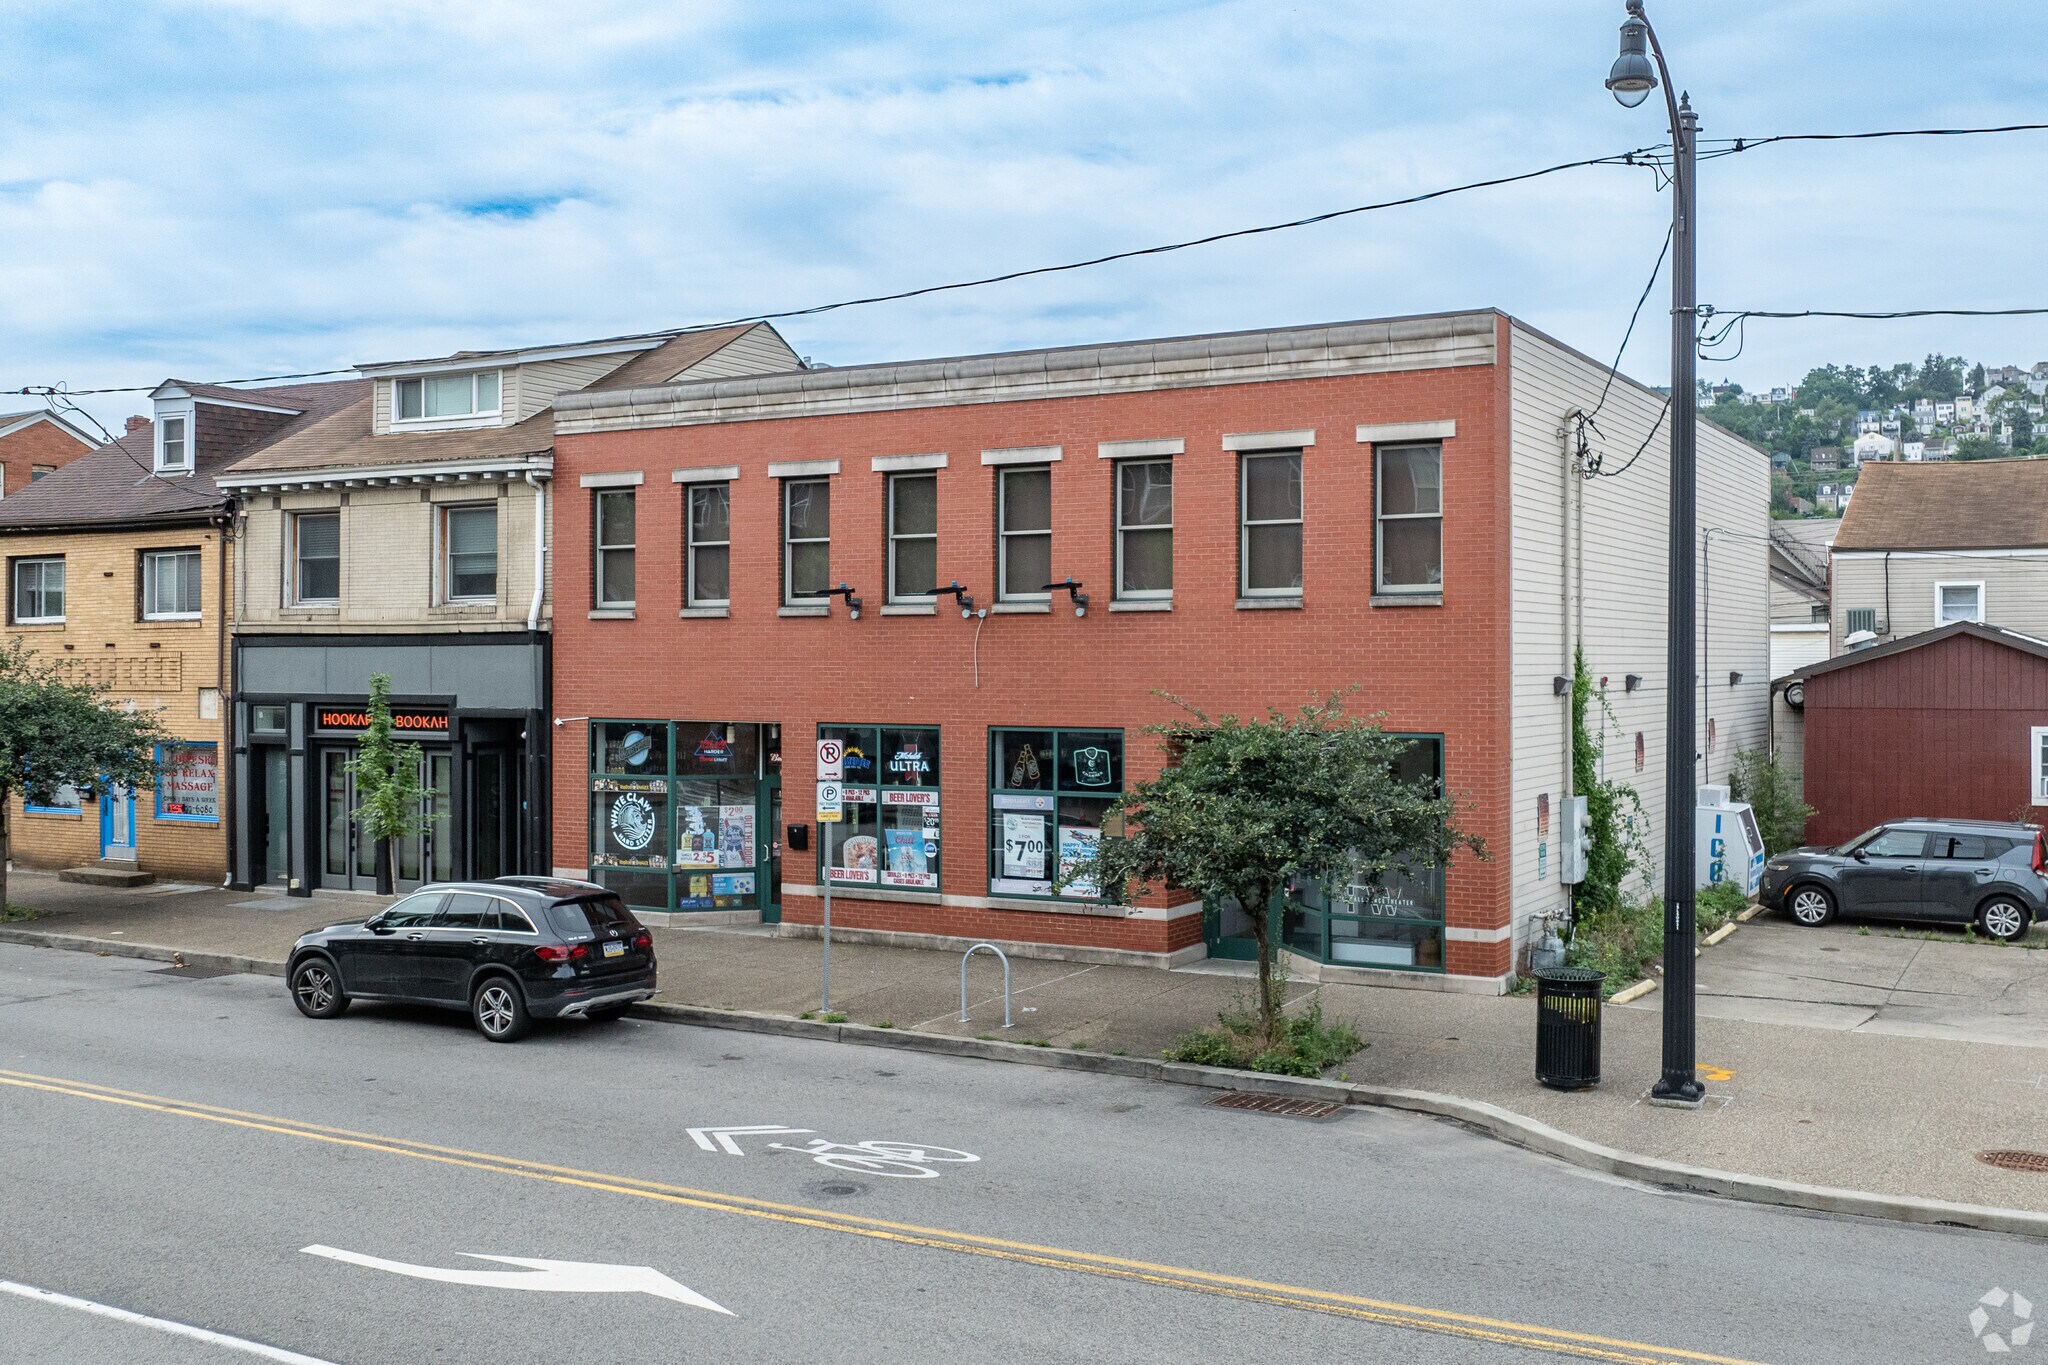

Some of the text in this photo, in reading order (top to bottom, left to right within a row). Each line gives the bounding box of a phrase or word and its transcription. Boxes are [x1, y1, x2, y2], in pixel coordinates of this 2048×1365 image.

[395, 715, 448, 728] BOOKAH
[889, 760, 931, 772] ULTRA
[167, 782, 214, 791] MASSAGE
[889, 792, 931, 803] BEER LOVER'S
[610, 792, 652, 829] WHITE CLAW
[618, 819, 653, 846] HARD SELTZER
[830, 868, 870, 880] BEER LOVER'S
[1387, 898, 1414, 906] THEATER
